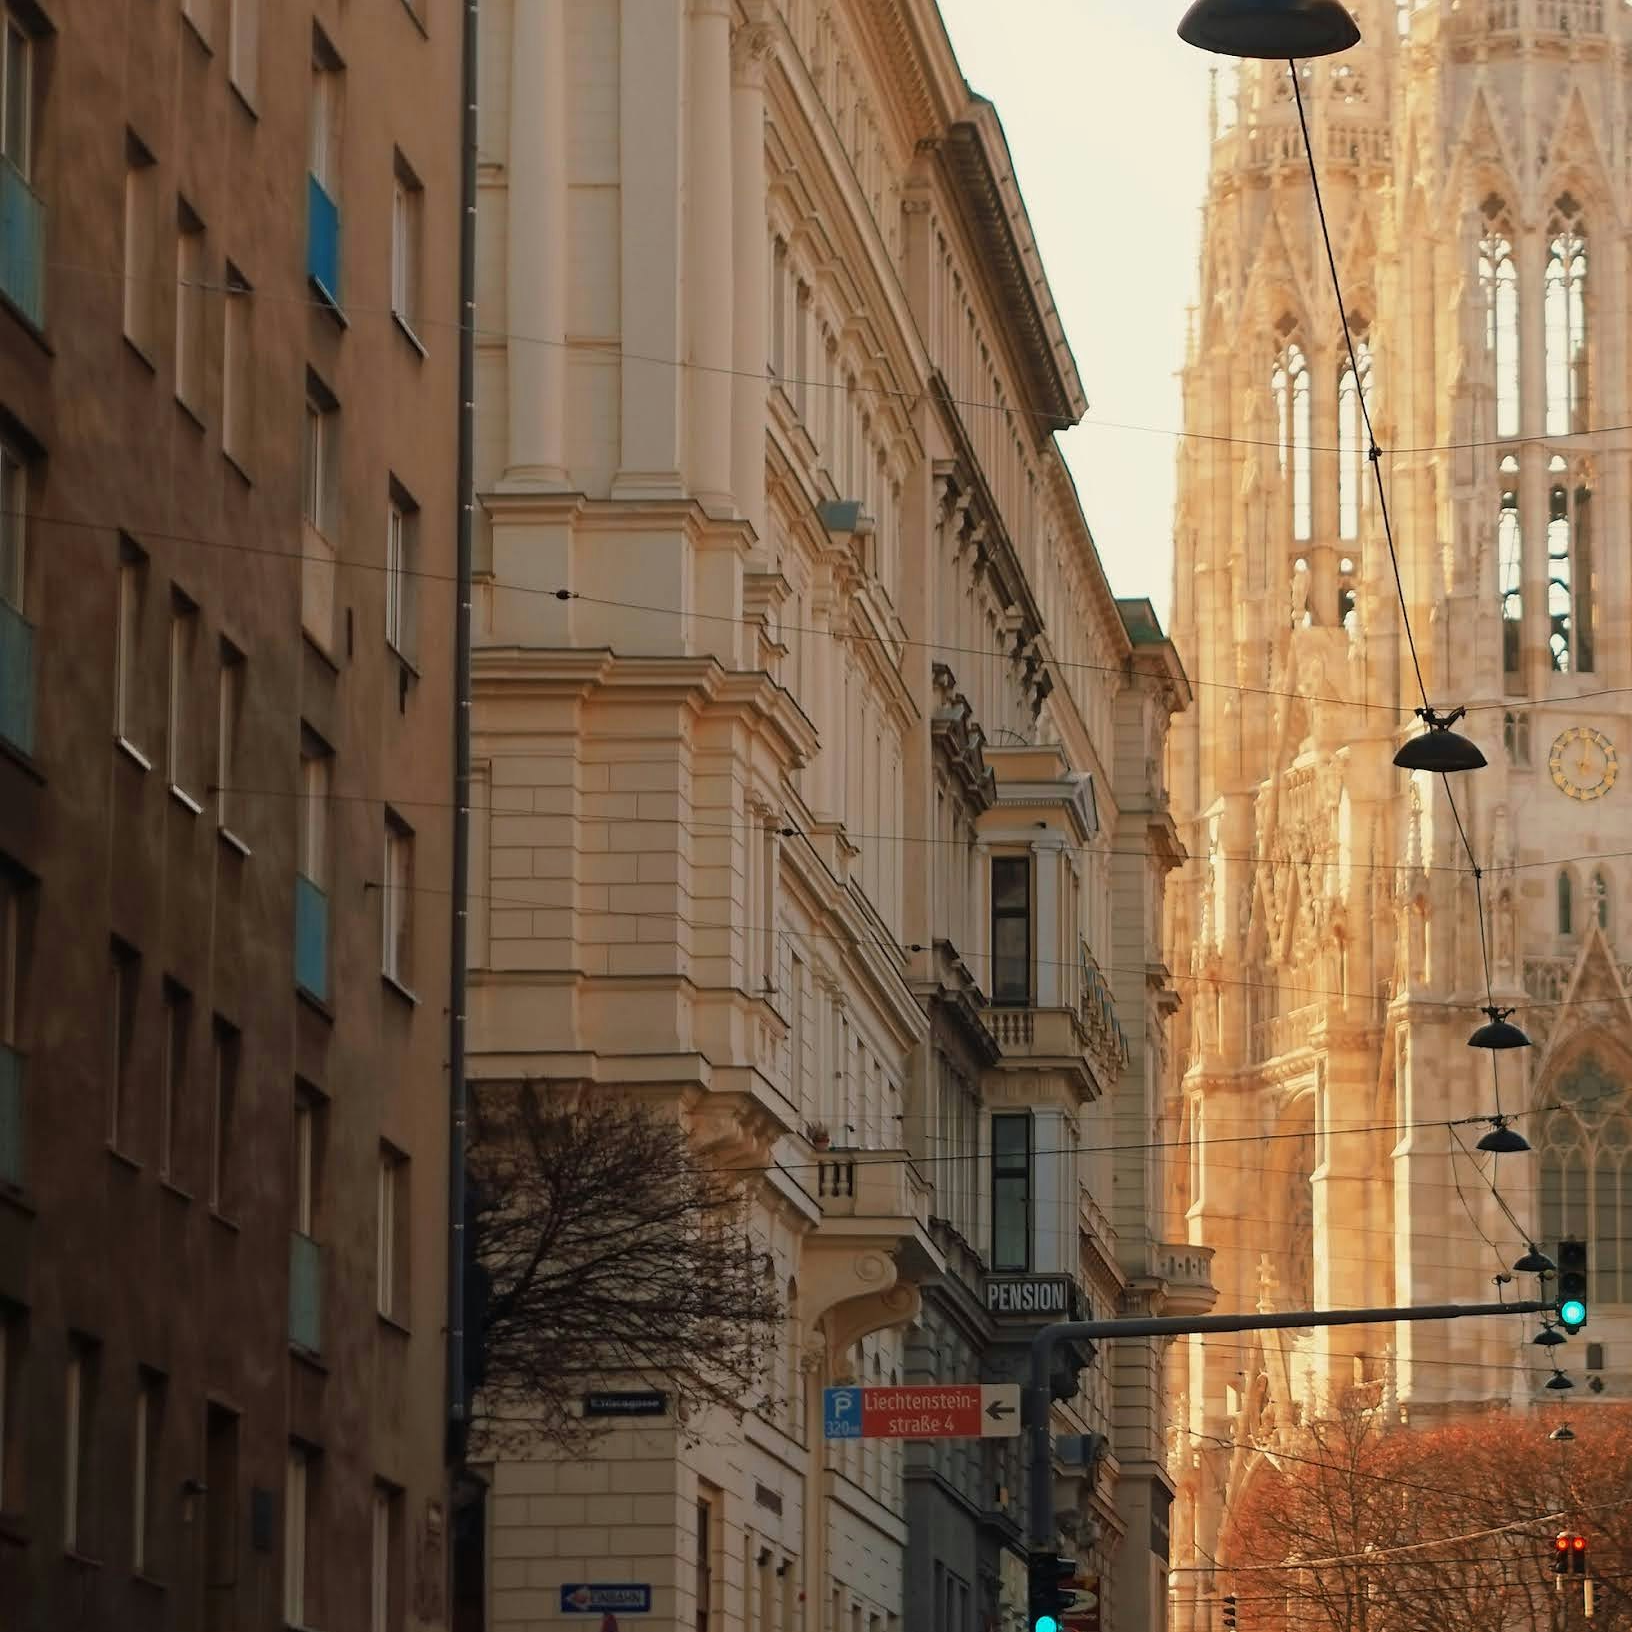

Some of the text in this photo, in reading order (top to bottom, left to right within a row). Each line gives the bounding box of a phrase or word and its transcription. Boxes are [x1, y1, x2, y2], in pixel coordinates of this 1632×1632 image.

[988, 1282, 1064, 1311] PENSION
[835, 1396, 851, 1418] P
[864, 1391, 978, 1411] Liechtenstein-
[889, 1415, 955, 1433] straße 4
